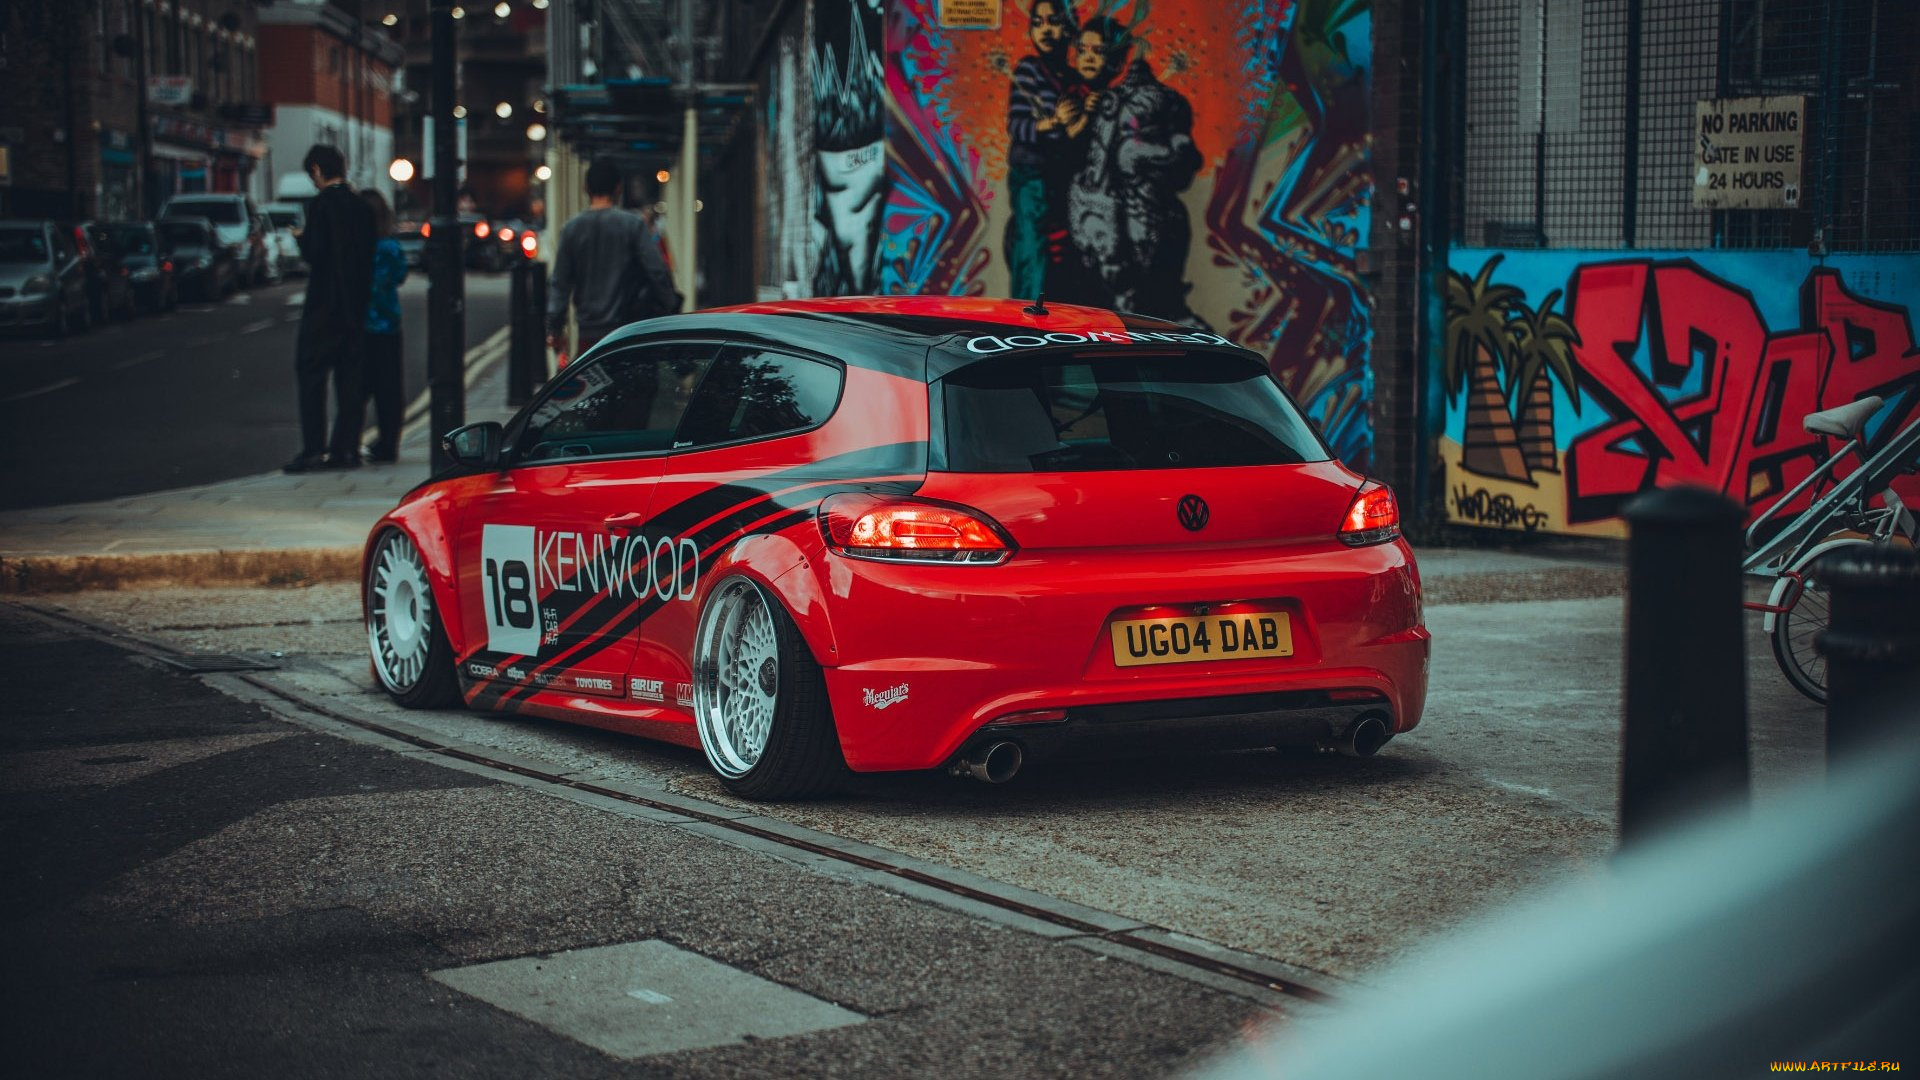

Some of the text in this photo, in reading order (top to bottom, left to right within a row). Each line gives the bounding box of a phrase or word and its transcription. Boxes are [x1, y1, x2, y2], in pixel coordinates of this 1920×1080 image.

[1702, 111, 1798, 134] NO PARKING
[1744, 146, 1760, 163] IN
[1765, 145, 1795, 163] USE
[1709, 171, 1784, 190] 24 HOURS
[966, 330, 1245, 354] KENWOOD
[538, 530, 699, 601] KENWOOD
[486, 558, 535, 630] 18
[1219, 618, 1279, 652] DAB
[470, 664, 499, 677] COBRA
[863, 682, 909, 706] Meguiar's
